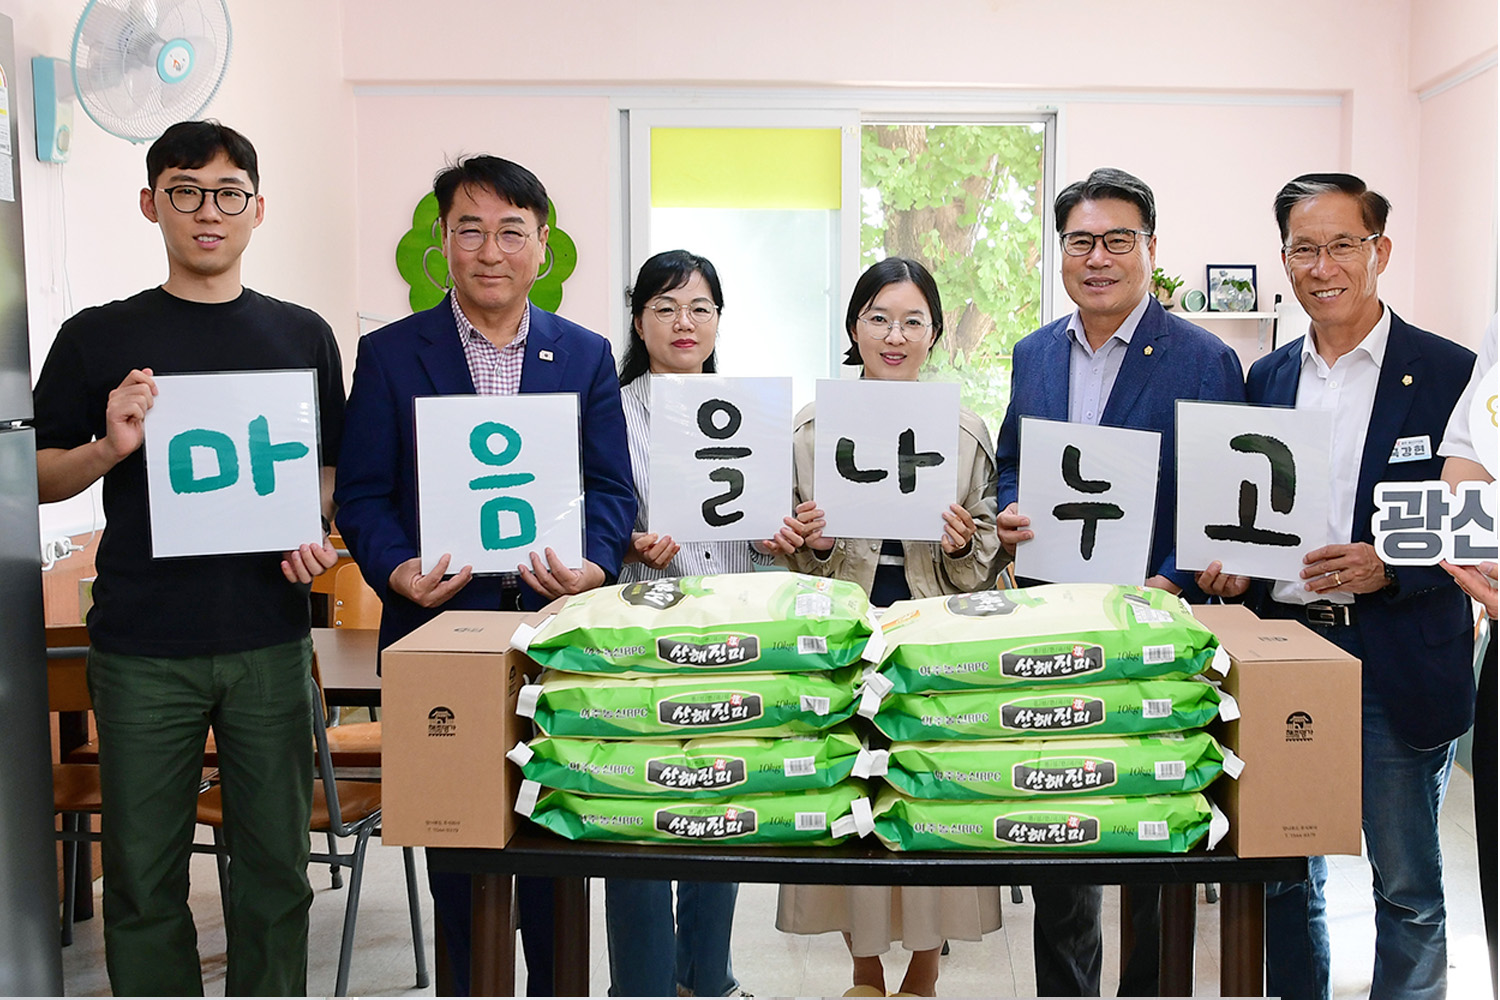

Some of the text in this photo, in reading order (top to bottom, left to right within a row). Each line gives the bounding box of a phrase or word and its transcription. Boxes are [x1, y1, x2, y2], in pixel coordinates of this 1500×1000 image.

[169, 414, 309, 496] 마
[695, 398, 752, 527] 을
[836, 428, 944, 495] 나
[469, 421, 537, 551] 음
[1204, 433, 1301, 547] 고
[1052, 444, 1125, 561] 누
[669, 643, 745, 665] 산해진미
[772, 640, 796, 652] 10kg
[1116, 650, 1141, 662] 10kg
[1014, 653, 1090, 677] 산해진미
[672, 703, 749, 725] 산해진미
[776, 698, 798, 711] 10kg
[1117, 704, 1141, 715] 10kg
[1014, 711, 1090, 729] 산해진미
[659, 764, 731, 788] 산해진미
[758, 763, 782, 775] 10kg
[1026, 769, 1103, 790] 산해진미
[1129, 766, 1153, 778] 10kg
[669, 814, 744, 836] 산해진미
[768, 816, 793, 827] 10kg
[1112, 825, 1136, 836] 10kg
[1009, 822, 1086, 843] 산해진미
